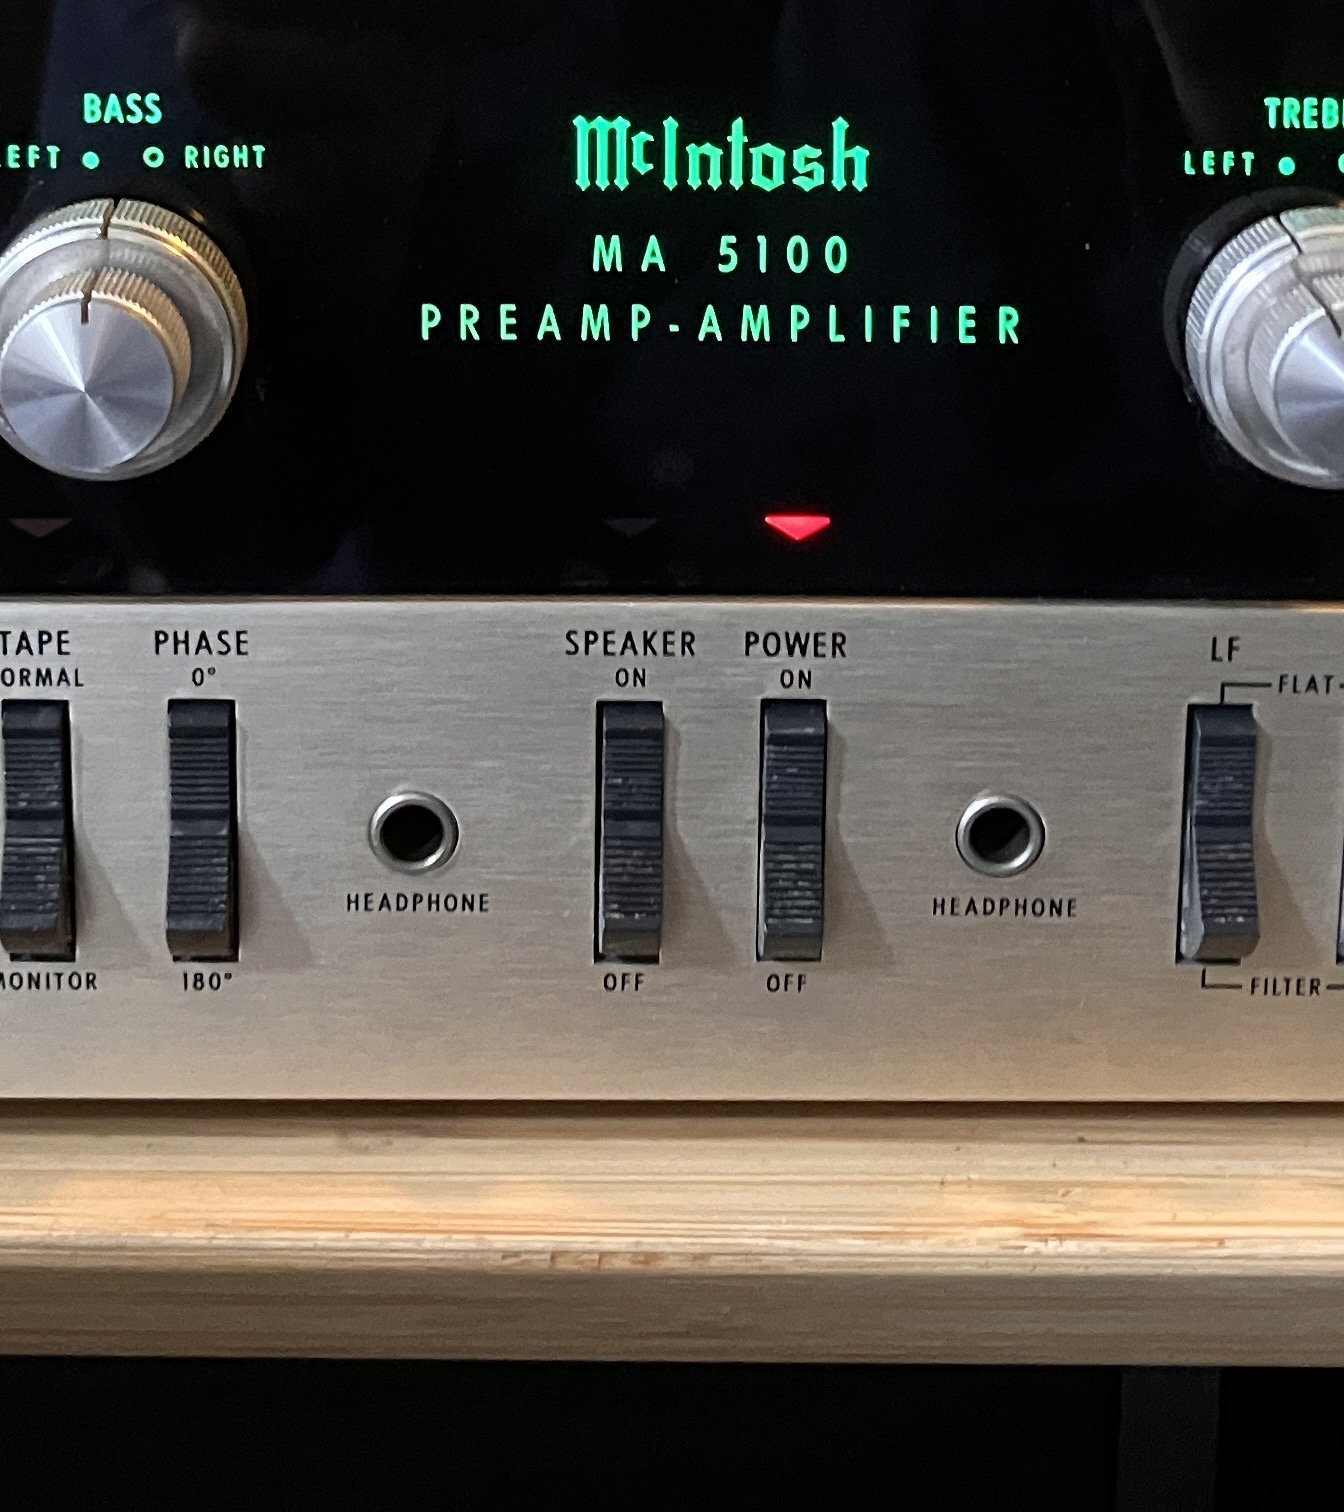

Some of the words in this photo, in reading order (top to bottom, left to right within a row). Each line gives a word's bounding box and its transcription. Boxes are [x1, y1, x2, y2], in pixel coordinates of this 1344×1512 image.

[83, 93, 162, 124] BASS
[185, 145, 265, 168] RIGHT
[573, 114, 870, 192] McIntosh
[1184, 151, 1254, 176] LEFT
[592, 234, 667, 272] MA
[717, 234, 849, 273] 5100
[420, 303, 1020, 344] PREAMP-AMPLIFIER
[154, 630, 248, 655] PHASE
[565, 630, 695, 657] SPEAKER
[743, 631, 846, 658] POWER
[1211, 637, 1240, 662] LF
[615, 668, 646, 688] ON
[779, 670, 812, 689] ON
[1278, 674, 1334, 694] FLAT
[346, 893, 488, 912] HEADPHONE
[933, 897, 1078, 917] HEADPHONE
[603, 972, 644, 991] OFF
[766, 972, 806, 992] OFF
[1250, 978, 1320, 995] FILTER
